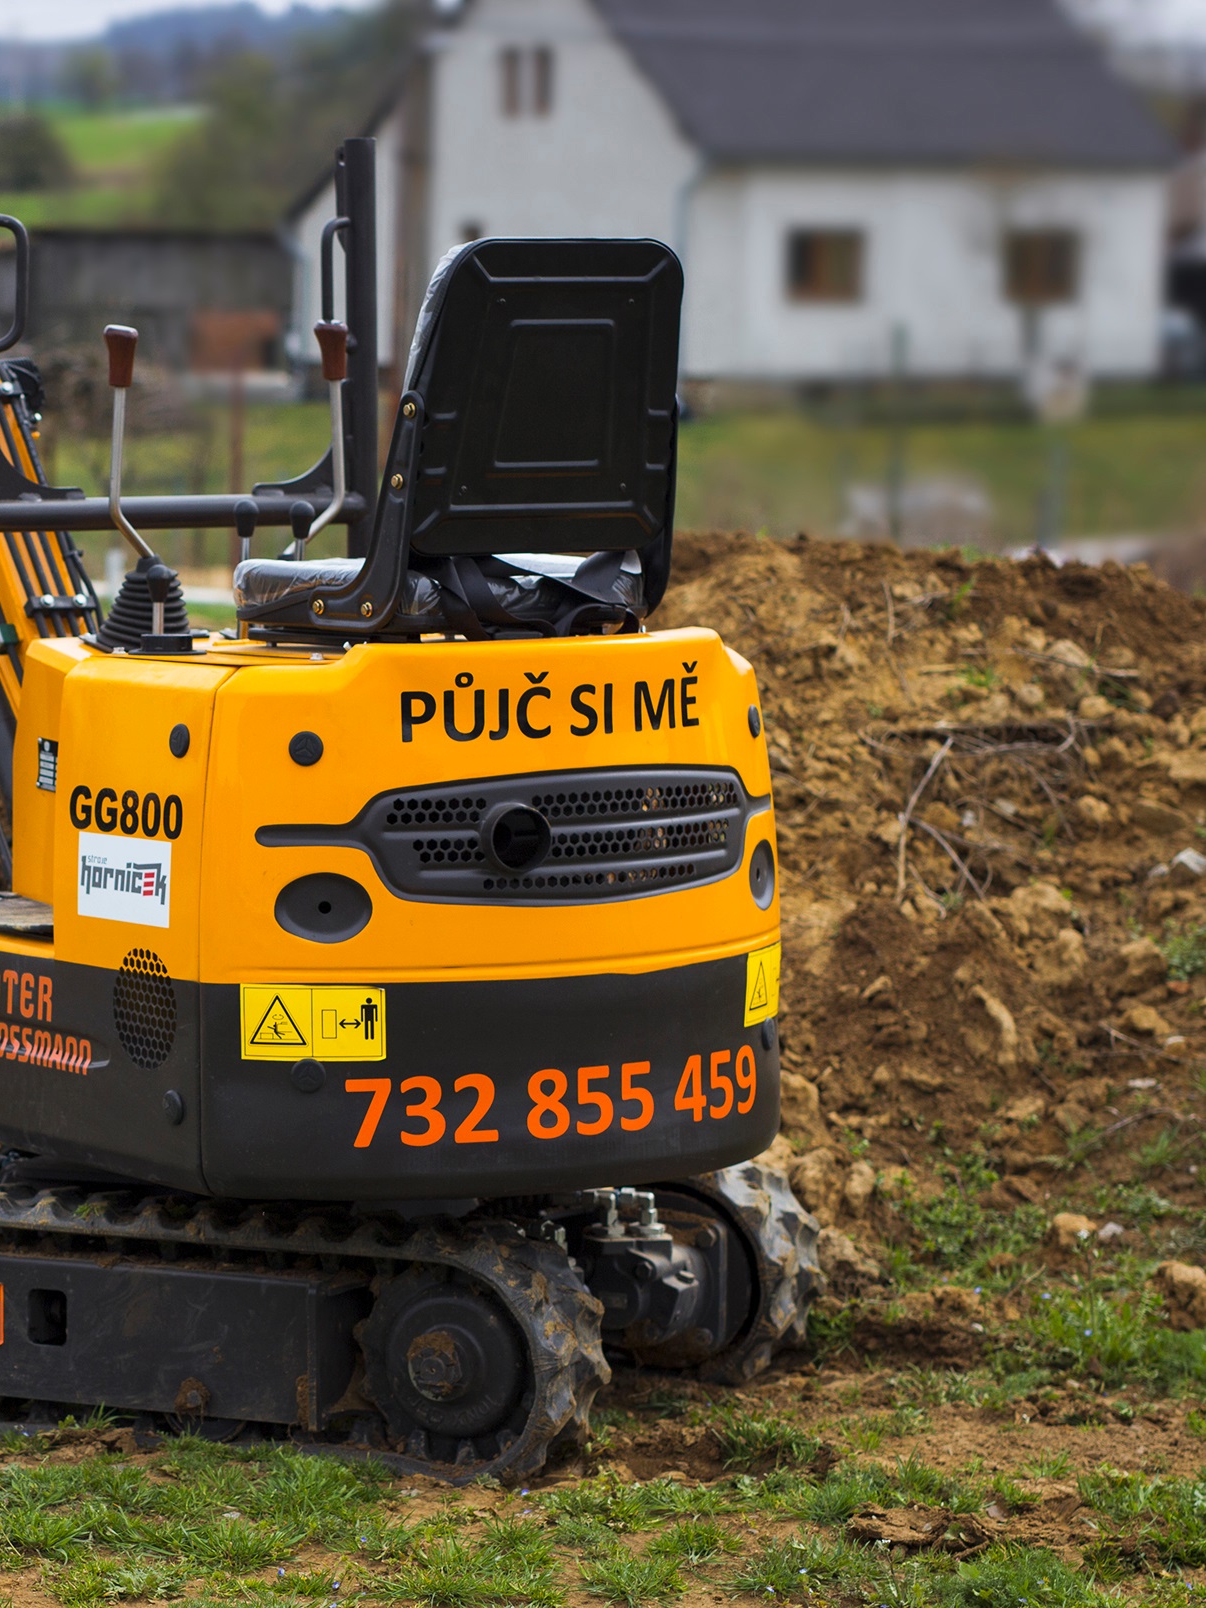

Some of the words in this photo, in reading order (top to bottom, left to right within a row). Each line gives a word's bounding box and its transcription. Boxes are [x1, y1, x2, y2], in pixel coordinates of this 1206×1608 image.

[400, 671, 551, 742] PŮJČ
[570, 683, 613, 736] SI
[633, 660, 700, 732] MĚ
[69, 784, 183, 840] GG800
[87, 854, 108, 865] stroje
[344, 1073, 499, 1148] 732
[526, 1060, 655, 1140] 855
[674, 1044, 757, 1122] 459
